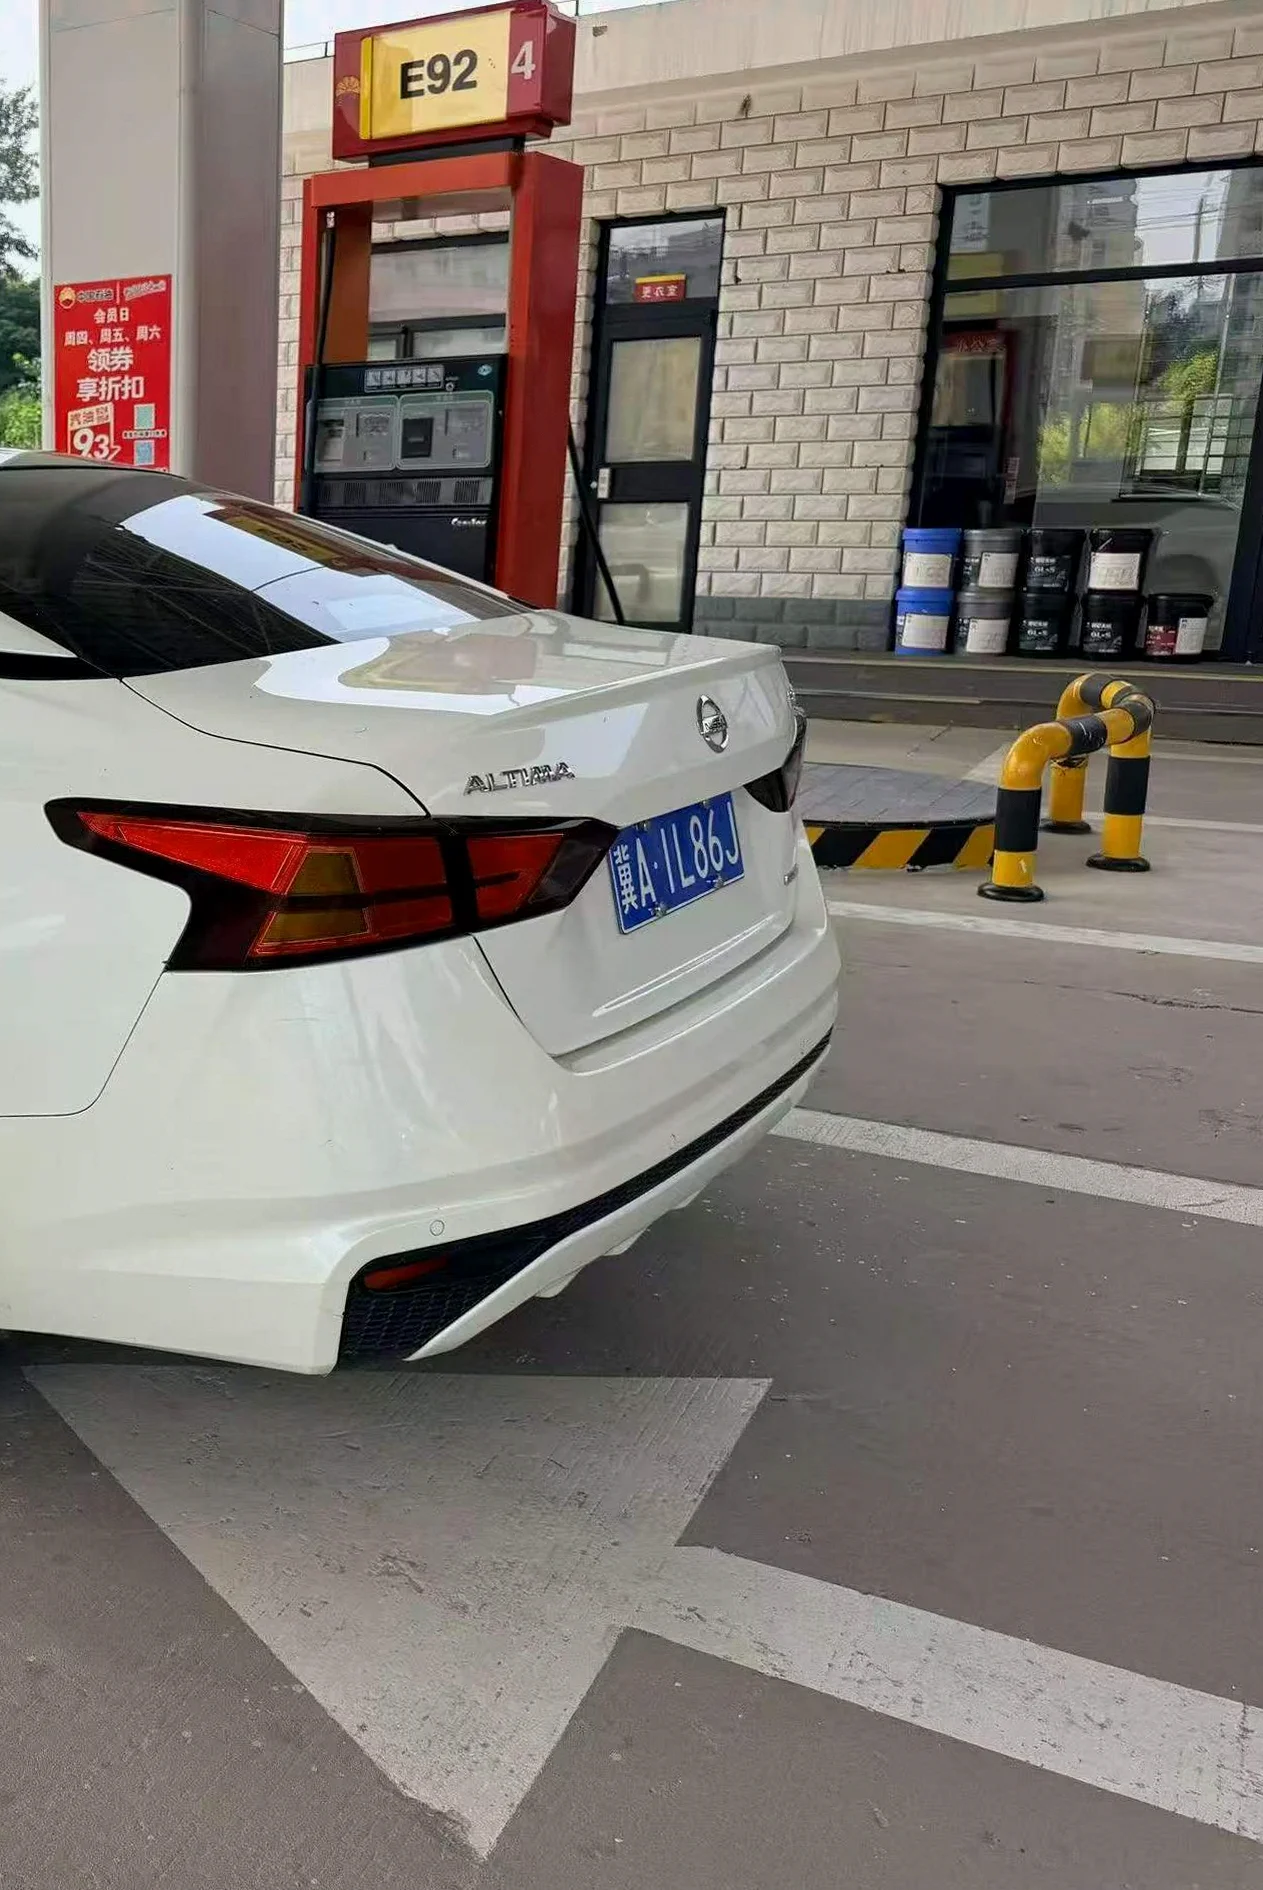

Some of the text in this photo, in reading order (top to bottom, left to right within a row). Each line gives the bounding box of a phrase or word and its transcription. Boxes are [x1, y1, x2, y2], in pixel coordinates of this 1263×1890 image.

[400, 49, 478, 100] E92
[511, 40, 536, 80] 4
[94, 307, 130, 324] 会员日
[87, 346, 134, 372] 领券
[76, 375, 145, 402] 享折扣
[463, 761, 577, 796] ALTIMA
